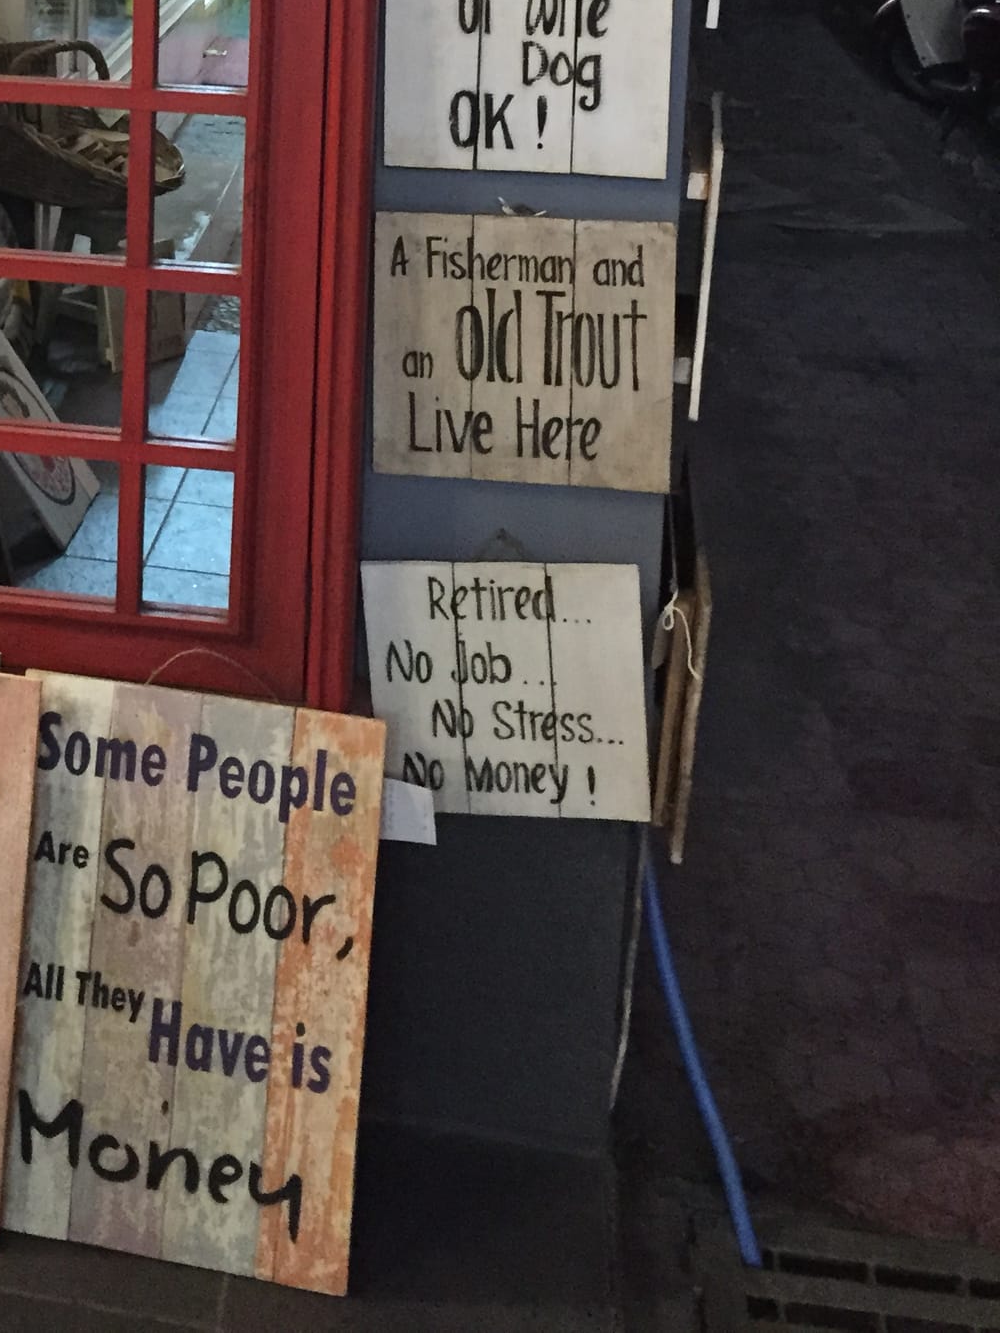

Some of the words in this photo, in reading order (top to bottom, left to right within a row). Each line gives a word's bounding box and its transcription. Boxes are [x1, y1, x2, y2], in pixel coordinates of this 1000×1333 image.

[522, 40, 603, 112] Dog
[389, 234, 409, 278] A
[425, 235, 576, 285] Fisherman
[592, 243, 645, 288] and
[402, 349, 434, 379] an
[455, 287, 523, 384] Old
[535, 289, 648, 392] Trout
[408, 391, 494, 454] Live
[516, 396, 603, 462] Here
[385, 638, 433, 685] No
[431, 698, 475, 738] No
[37, 711, 167, 787] Some
[187, 733, 357, 823] People
[402, 751, 445, 791] No
[33, 830, 89, 869] Are
[100, 838, 172, 919] So
[187, 850, 354, 961] Poor,
[23, 962, 65, 1002] All
[75, 970, 146, 1024] They
[148, 997, 272, 1084] Have
[291, 1022, 332, 1094] is
[18, 1089, 303, 1244] Money
